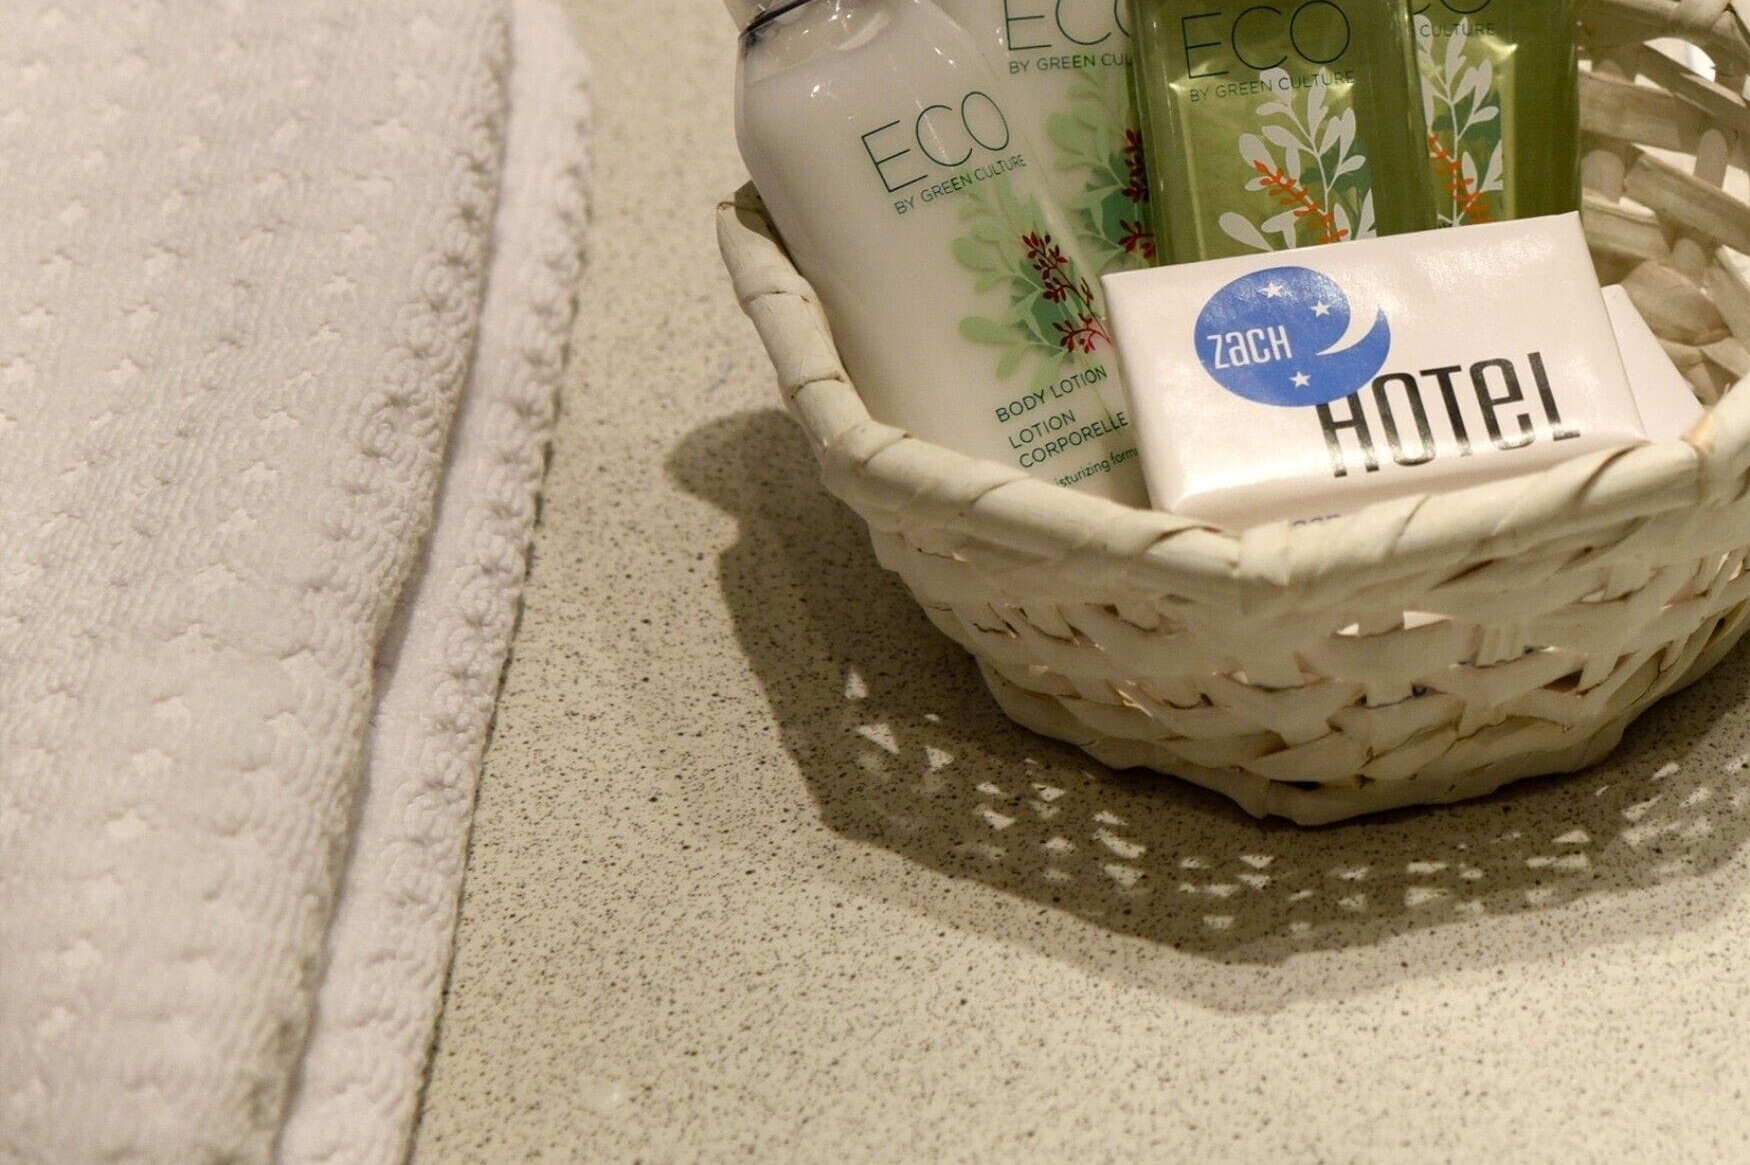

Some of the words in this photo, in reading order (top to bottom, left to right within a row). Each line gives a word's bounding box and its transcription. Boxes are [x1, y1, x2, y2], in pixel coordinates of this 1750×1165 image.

[1181, 0, 1350, 79] ECO
[1420, 23, 1496, 37] CULTURE
[1009, 60, 1030, 74] BY
[1037, 55, 1096, 71] GREEN
[1190, 87, 1209, 102] BY
[1215, 79, 1273, 98] GREEN
[1279, 70, 1354, 91] CULTURE
[861, 91, 1010, 193] ECO
[894, 196, 915, 216] BY
[920, 173, 973, 203] GREEN
[974, 154, 1027, 181] CULTURE
[995, 389, 1046, 423] BODY
[1050, 365, 1108, 399] LOTION
[1008, 409, 1077, 449] LOTION
[1019, 412, 1129, 468] CORPORELLE
